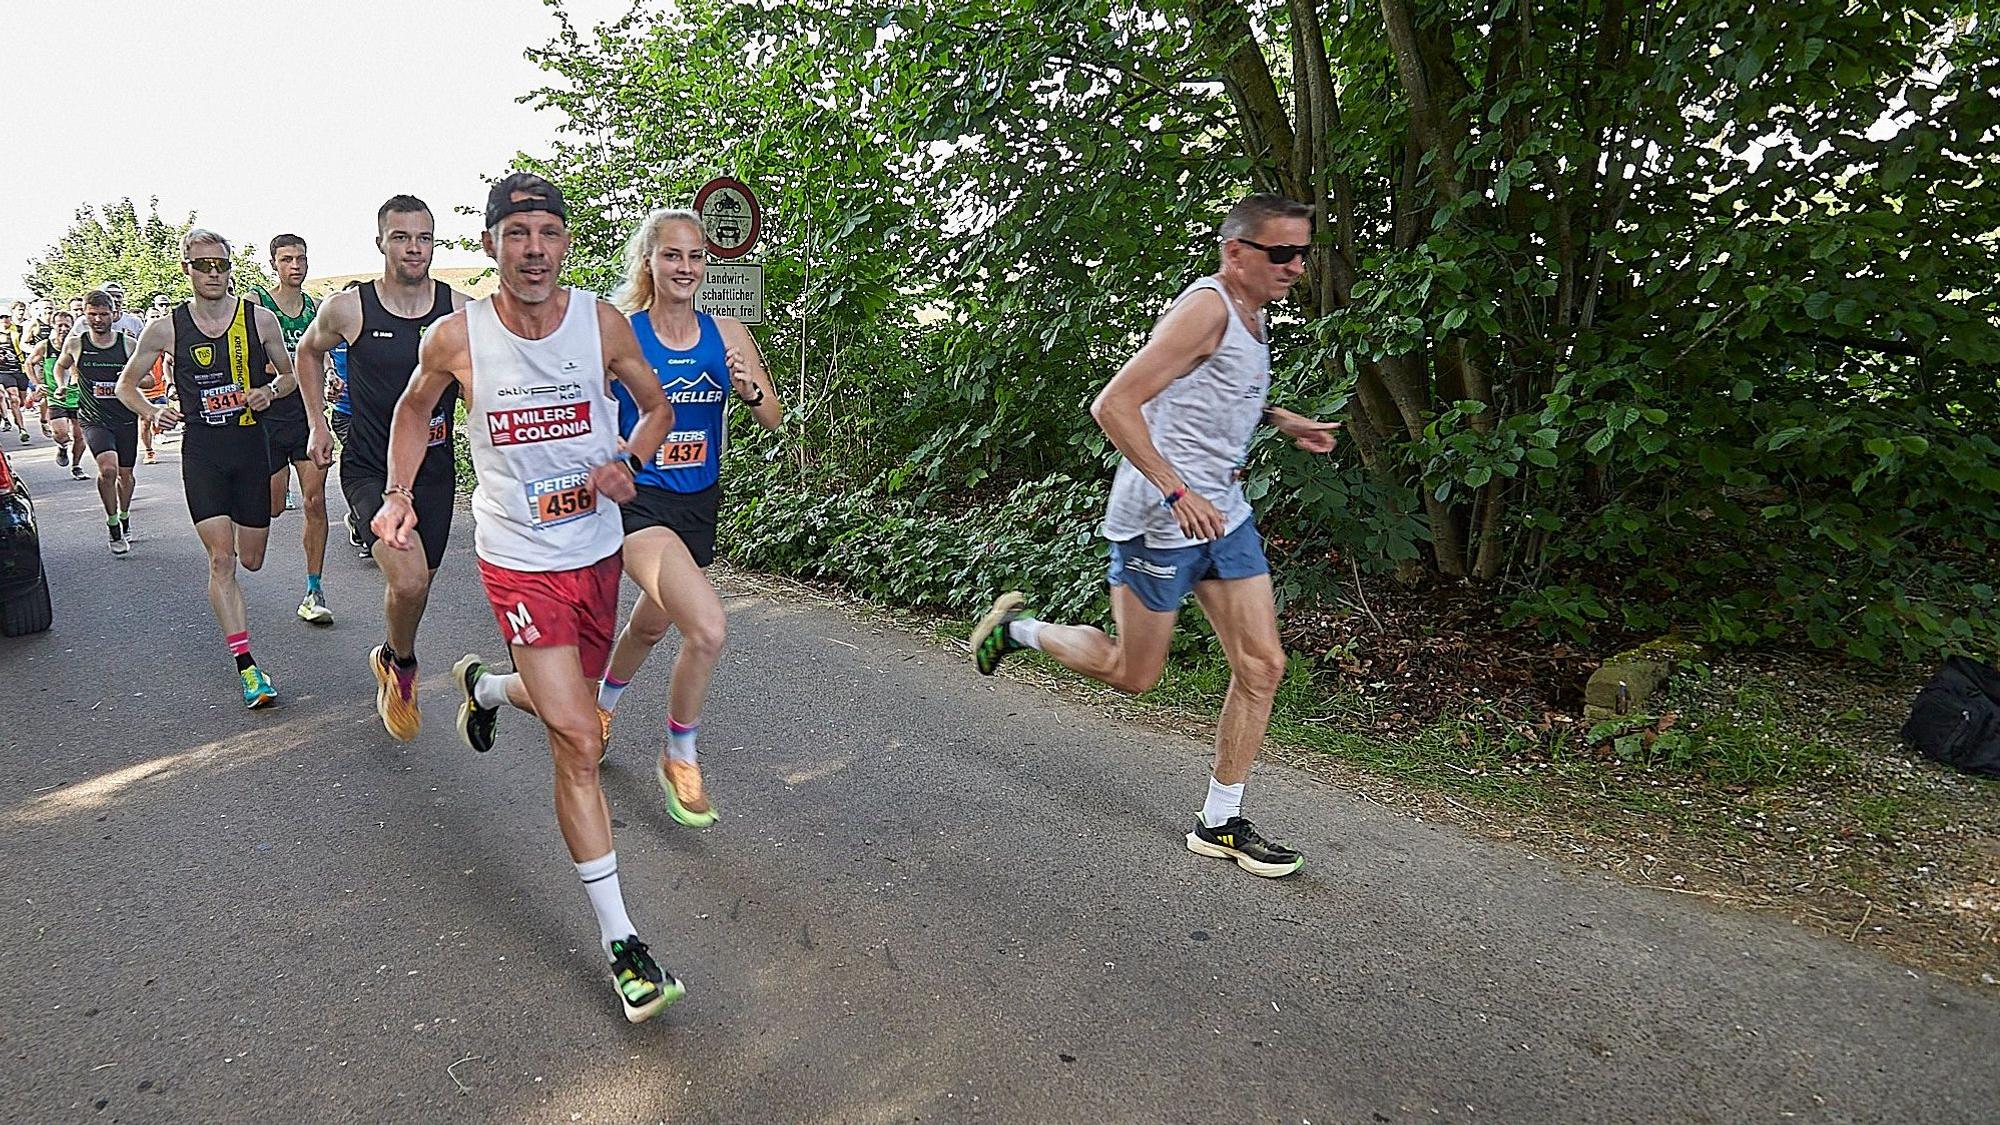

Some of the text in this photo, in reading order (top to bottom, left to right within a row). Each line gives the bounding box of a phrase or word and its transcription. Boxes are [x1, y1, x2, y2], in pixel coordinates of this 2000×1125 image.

[706, 271, 750, 285] Landwirt-
[702, 289, 755, 301] schaftlicher
[701, 304, 756, 317] Verkehr frei
[203, 383, 237, 397] PETERS
[665, 390, 723, 404] -KELLER
[210, 392, 239, 410] 341
[489, 413, 510, 434] M
[512, 407, 577, 426] MILERS
[427, 424, 444, 442] 58
[514, 419, 591, 442] COLONIA
[667, 430, 706, 443] ETERS
[668, 443, 705, 463] 437
[533, 472, 591, 495] PETERS
[546, 487, 591, 517] 456
